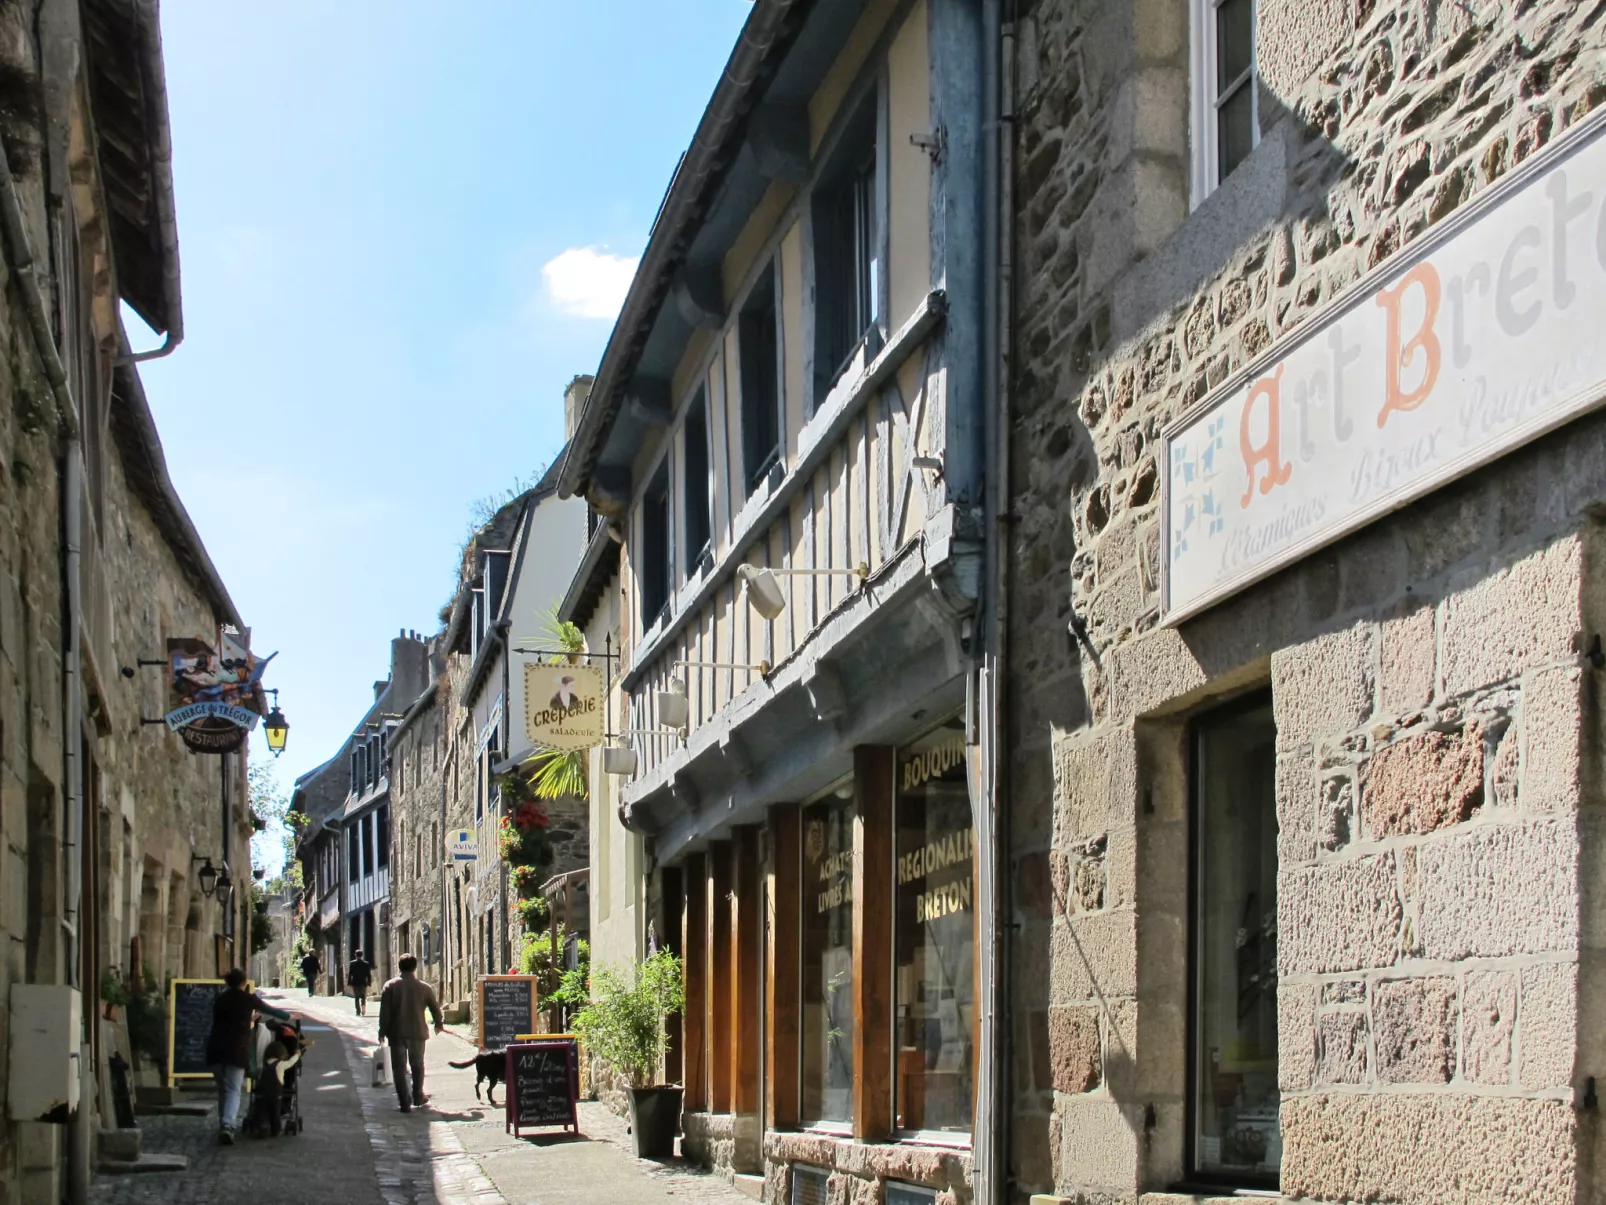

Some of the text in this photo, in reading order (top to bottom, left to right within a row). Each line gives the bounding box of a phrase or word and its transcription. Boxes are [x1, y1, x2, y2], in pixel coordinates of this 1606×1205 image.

[1376, 168, 1606, 430] Bret
[169, 704, 207, 727] AUBERGE
[916, 877, 971, 924] BRETON
